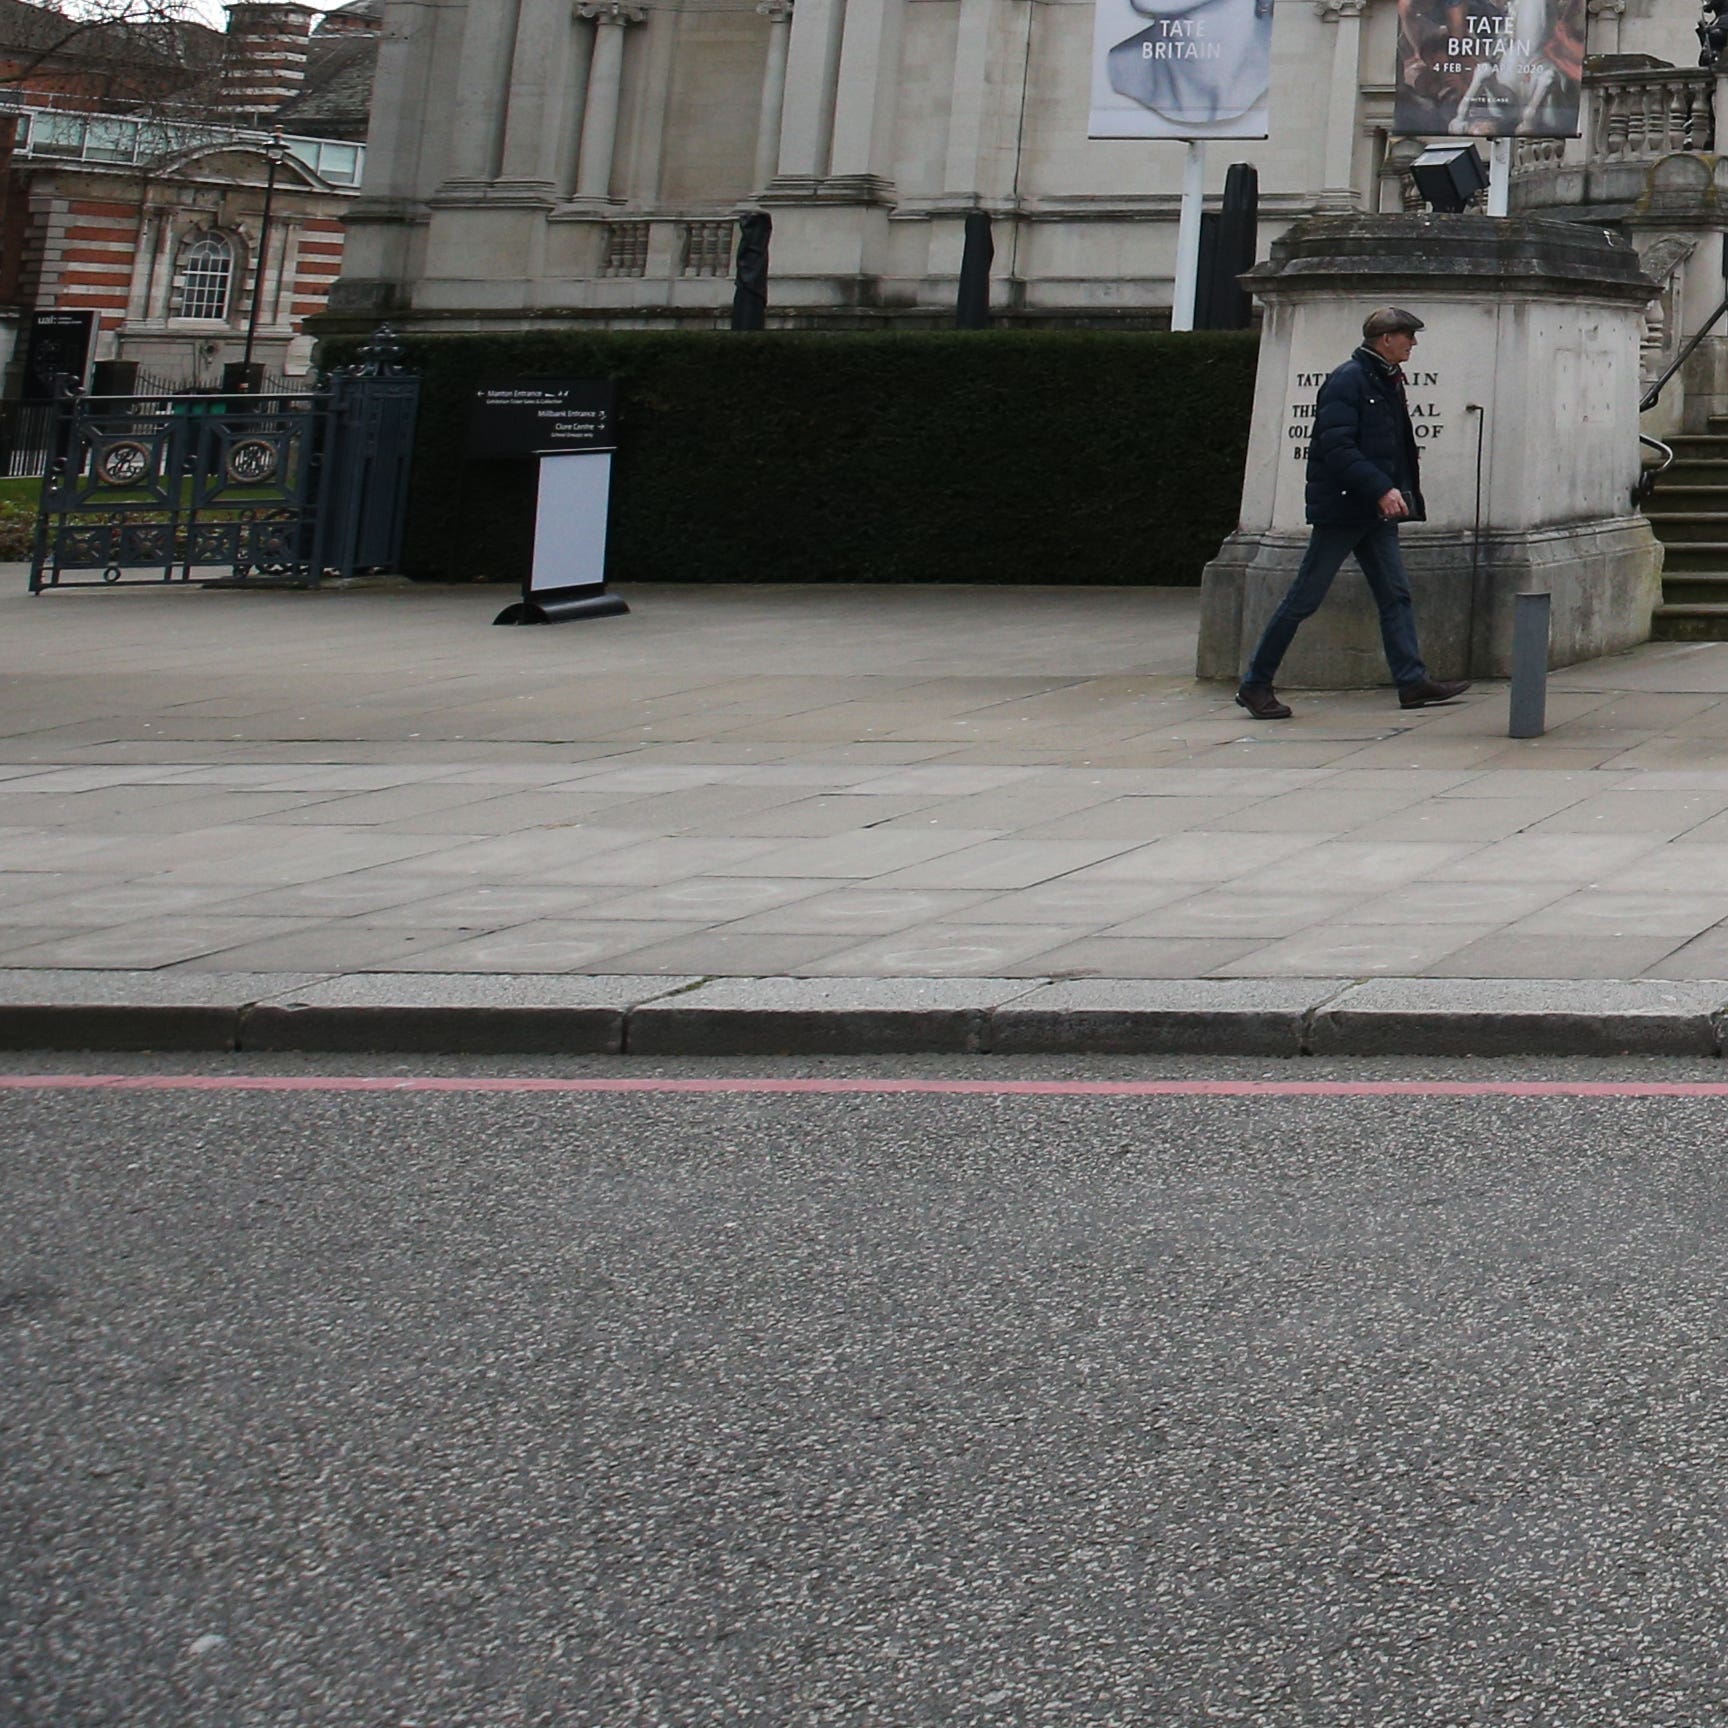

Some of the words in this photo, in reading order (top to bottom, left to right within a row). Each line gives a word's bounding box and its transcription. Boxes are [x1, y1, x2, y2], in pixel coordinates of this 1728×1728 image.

[1160, 20, 1206, 37] TATE
[1466, 16, 1514, 34] TATE
[1142, 41, 1220, 59] BRITAIN
[1448, 38, 1530, 56] BRITAIN
[1433, 63, 1440, 72] 4
[1444, 63, 1462, 72] FEB
[1518, 64, 1544, 74] 2020
[1414, 425, 1444, 438] OF
